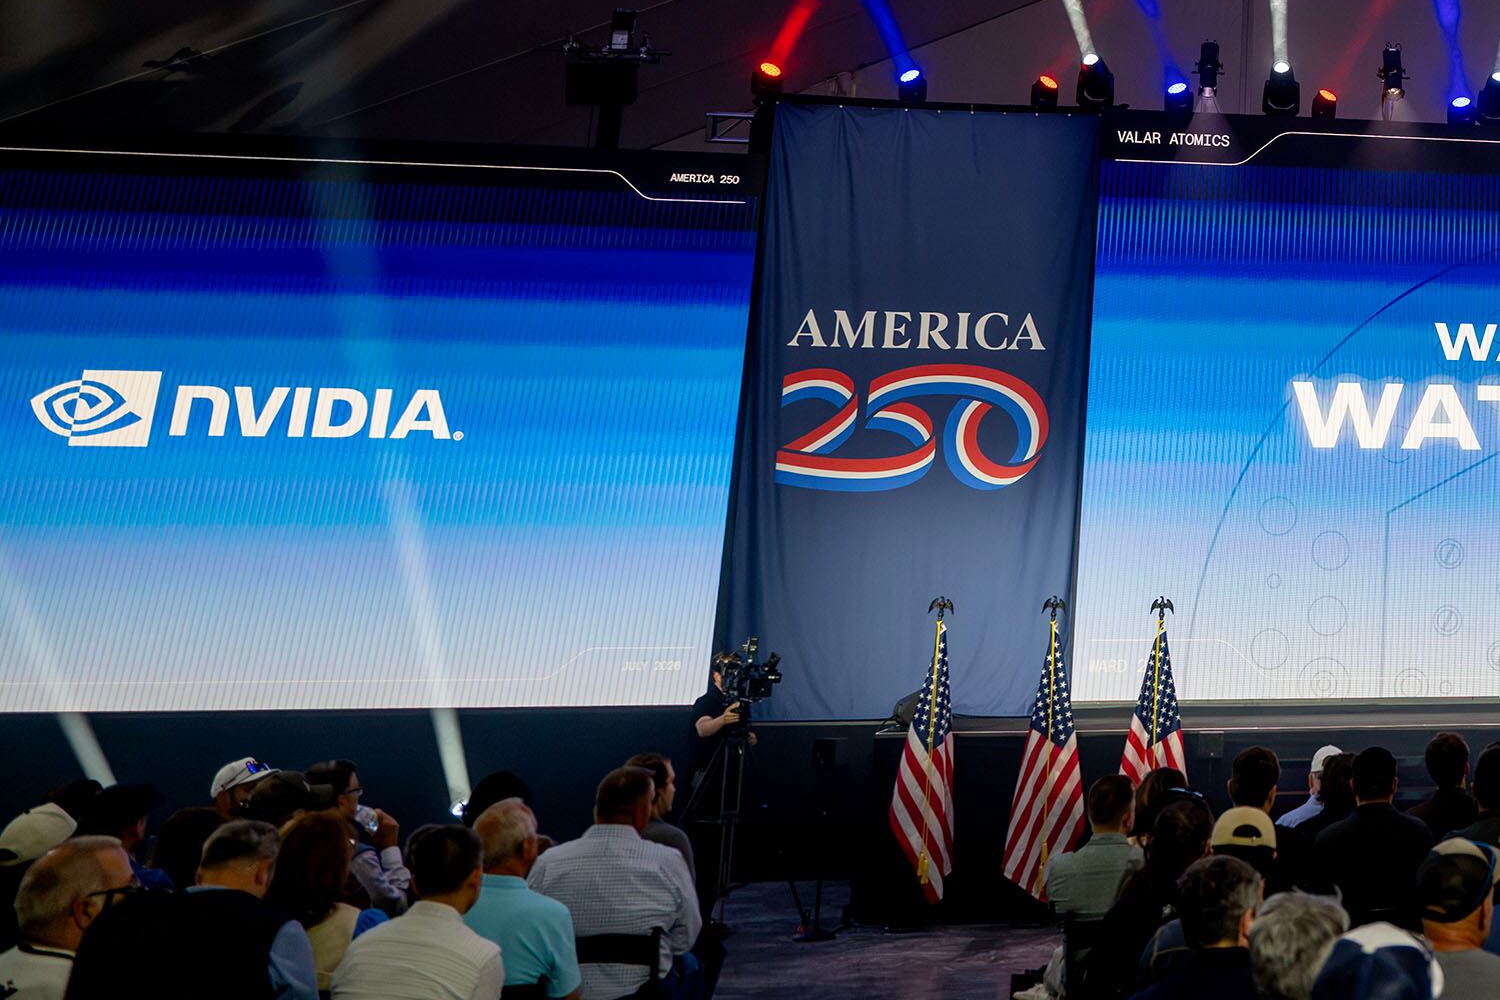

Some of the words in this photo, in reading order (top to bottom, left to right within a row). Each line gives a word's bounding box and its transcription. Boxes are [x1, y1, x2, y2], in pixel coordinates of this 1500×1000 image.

[1117, 130, 1161, 145] VALAR
[1169, 132, 1230, 147] ATOMICS
[669, 172, 715, 184] AMERICA
[719, 174, 740, 185] 250
[786, 308, 1047, 350] AMERICA
[774, 363, 1050, 492] 250
[622, 661, 648, 671] JULY
[654, 660, 681, 671] 2026
[1088, 660, 1127, 673] WARD
